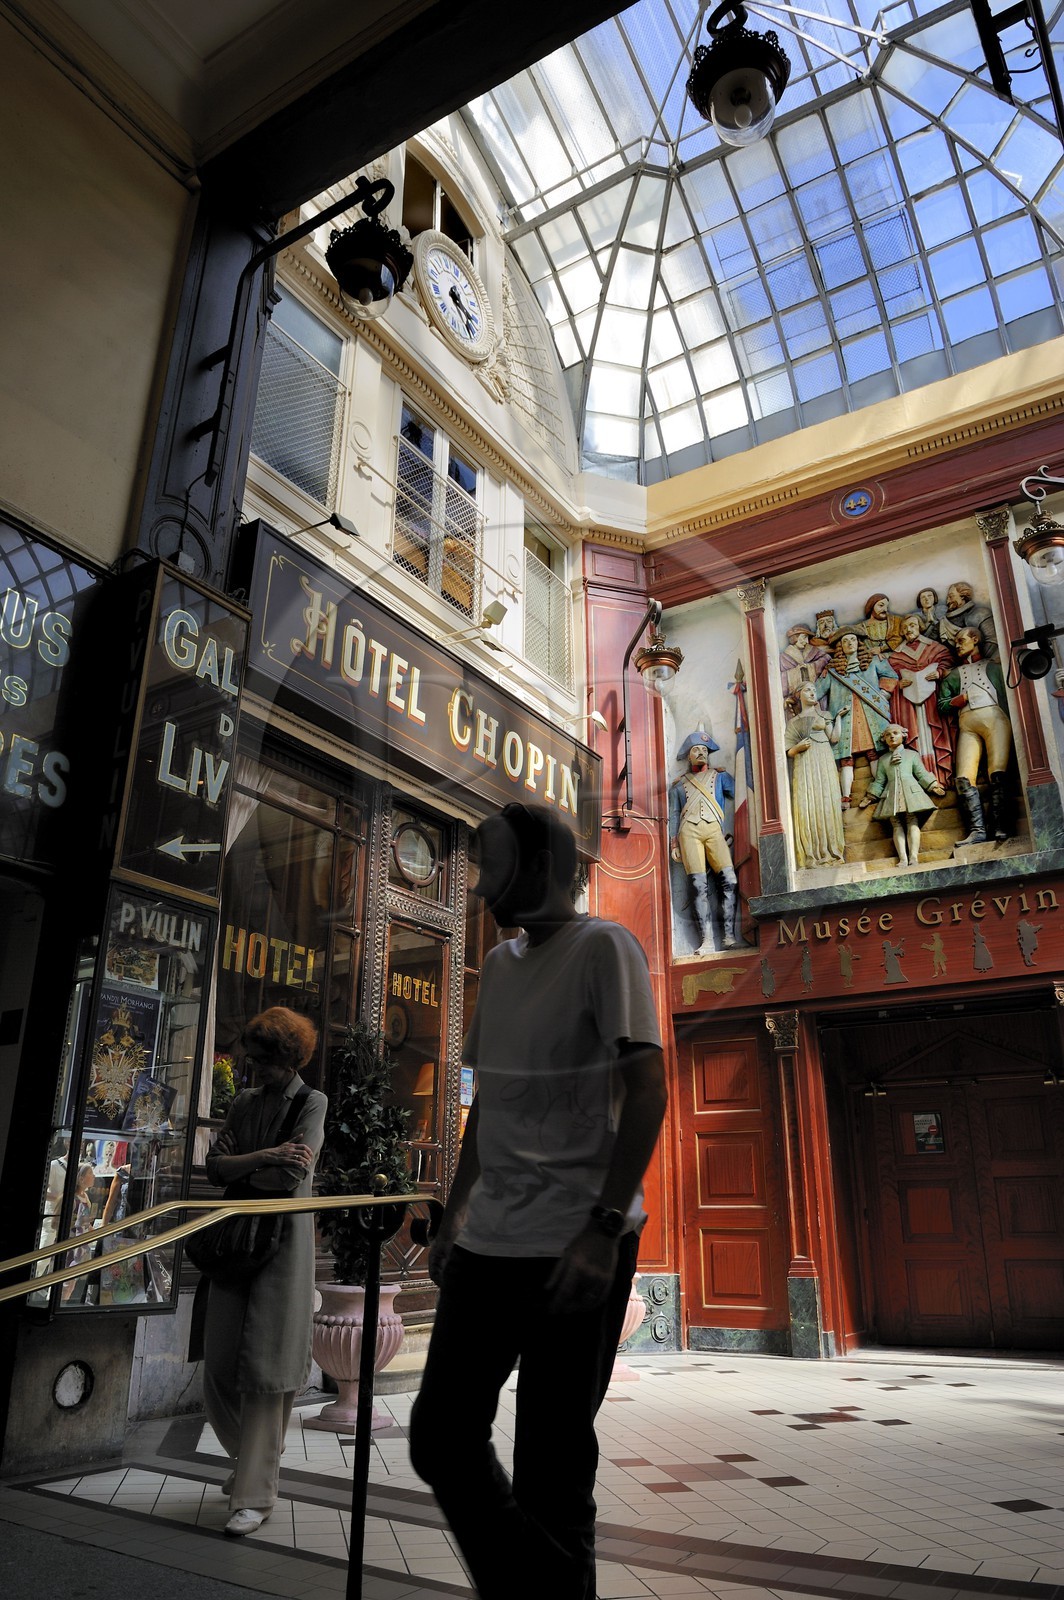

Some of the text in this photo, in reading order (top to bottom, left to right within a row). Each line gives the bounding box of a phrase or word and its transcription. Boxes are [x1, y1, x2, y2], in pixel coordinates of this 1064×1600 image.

[164, 609, 238, 696] GAL
[0, 670, 28, 706] S
[290, 575, 581, 816] HÔTEL CHOPIN
[218, 713, 234, 738] D
[157, 722, 230, 804] LIV
[777, 883, 1061, 946] Musée Grévin
[222, 924, 320, 994] HOTEL
[392, 972, 439, 1008] HOTEL
